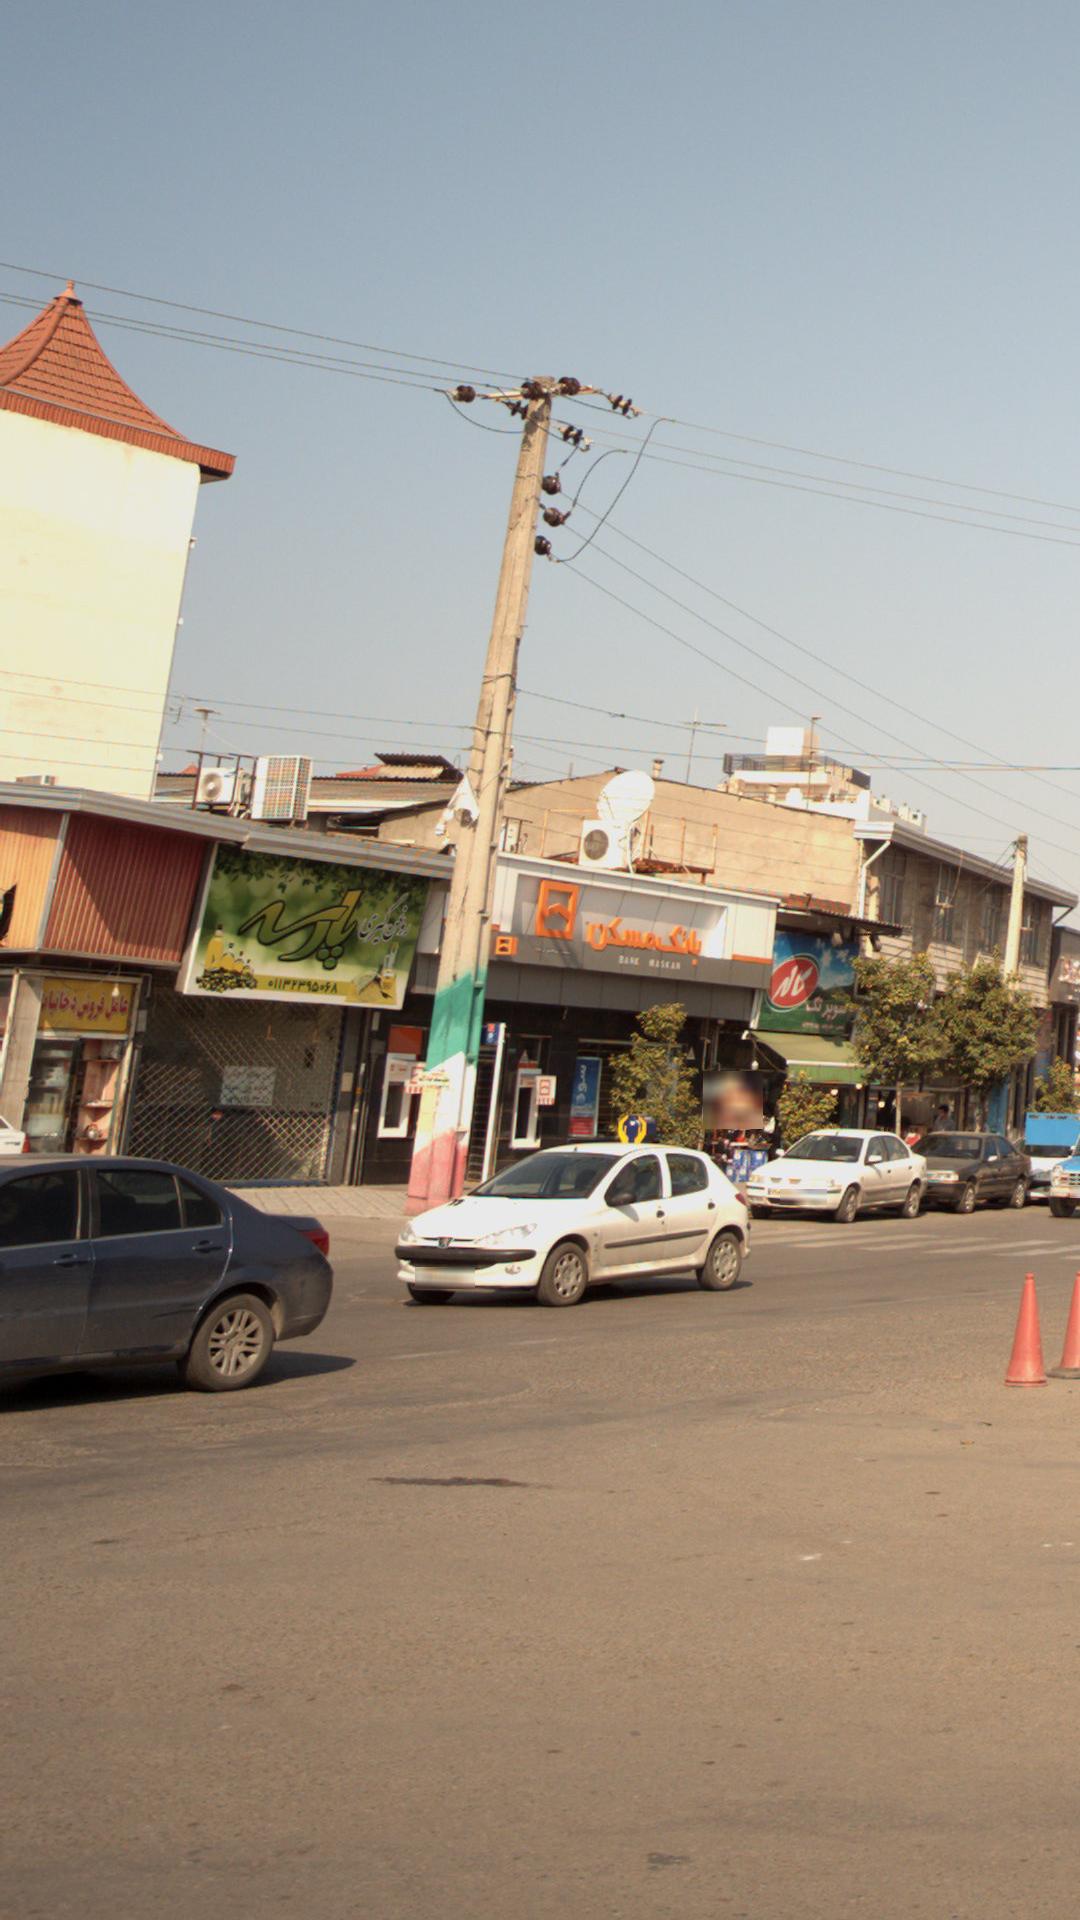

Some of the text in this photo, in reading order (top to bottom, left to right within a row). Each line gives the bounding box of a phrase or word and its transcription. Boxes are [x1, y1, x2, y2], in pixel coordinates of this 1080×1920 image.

[585, 915, 703, 967] بانک مسکن
[618, 954, 681, 970] BANK MASKAN
